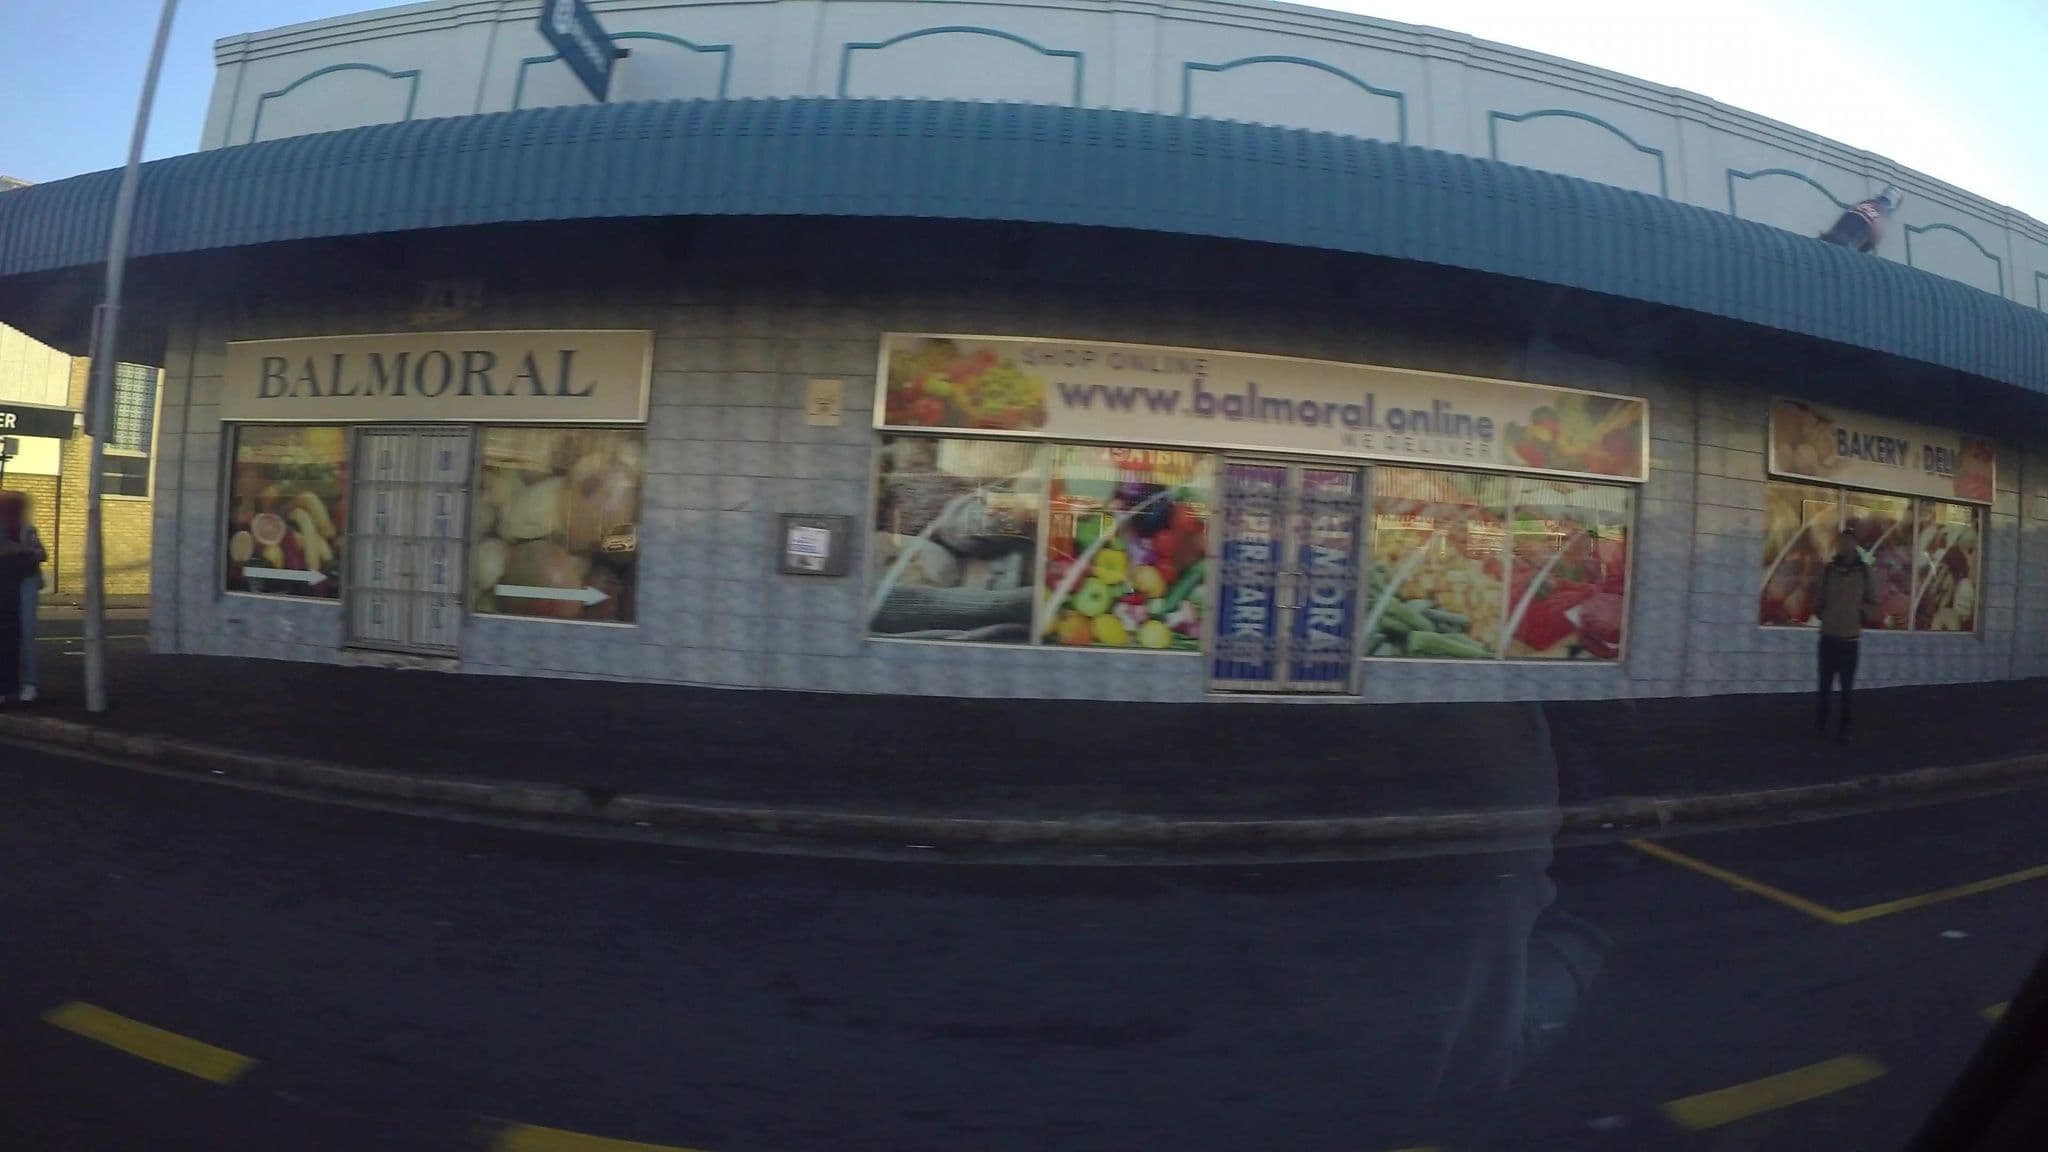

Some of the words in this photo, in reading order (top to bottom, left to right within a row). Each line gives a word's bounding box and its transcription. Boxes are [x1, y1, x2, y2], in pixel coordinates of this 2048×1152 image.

[258, 349, 597, 398] BALMORAL
[1056, 378, 1494, 440] www.balmoral.online
[1836, 427, 1908, 468] BAKERY
